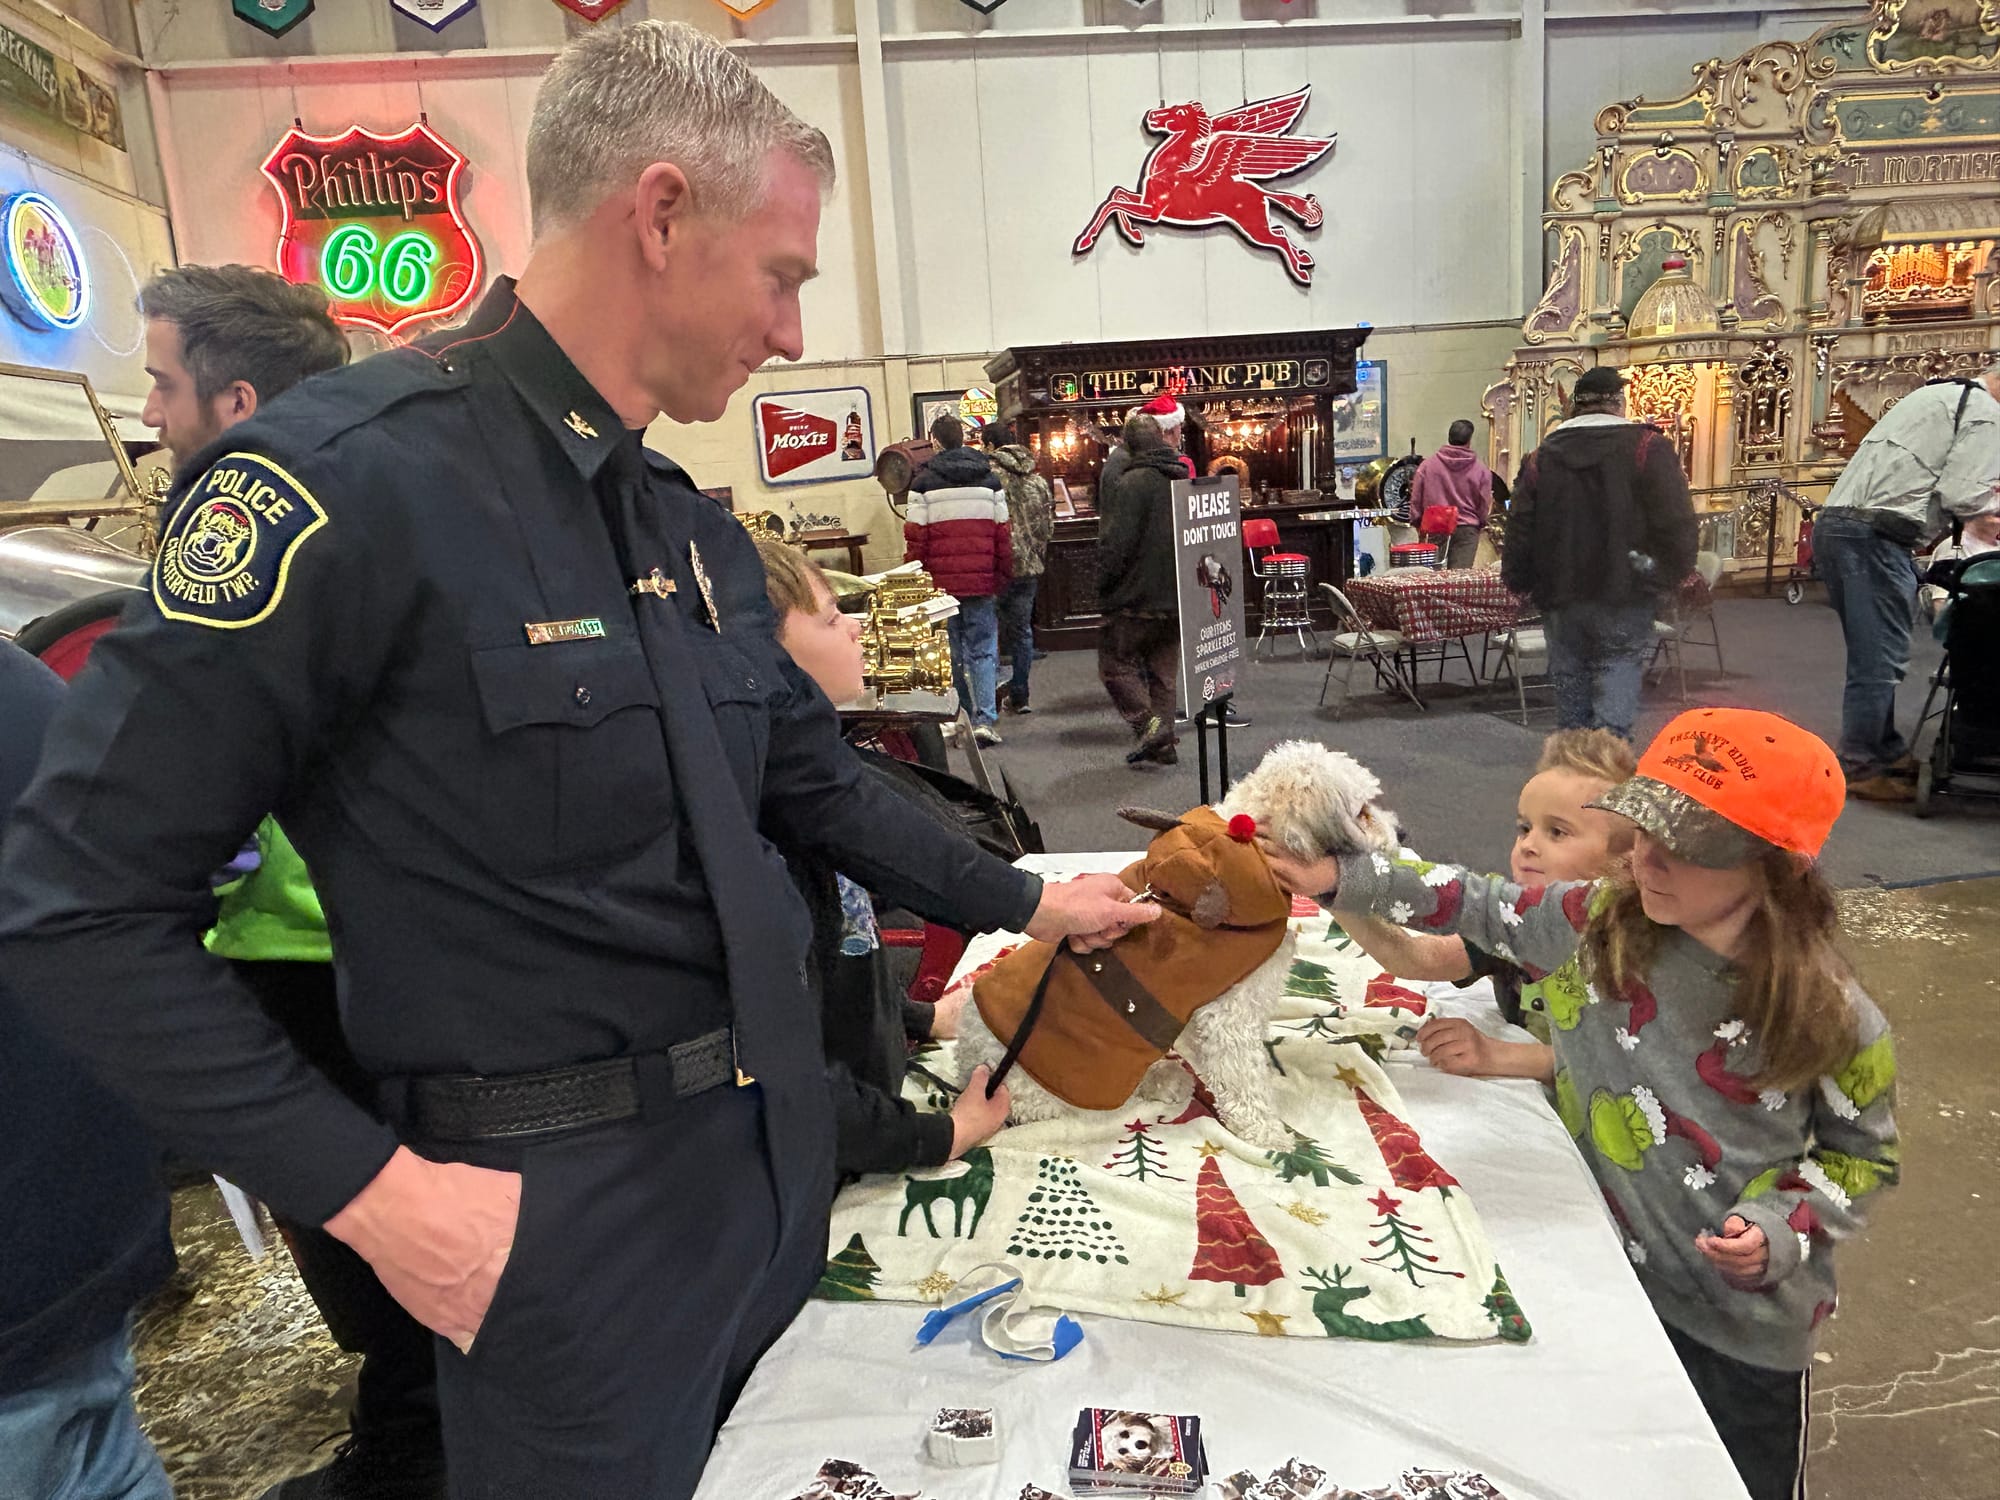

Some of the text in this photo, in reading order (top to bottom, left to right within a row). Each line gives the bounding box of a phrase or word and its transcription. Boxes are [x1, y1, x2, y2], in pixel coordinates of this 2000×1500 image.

[280, 152, 445, 220] Phillips
[321, 224, 437, 306] 66
[1089, 371, 1138, 392] THE
[1244, 363, 1291, 386] PUB
[768, 431, 829, 454] MOXIE
[205, 469, 294, 526] POLICE
[1188, 491, 1231, 520] PLEASE
[1211, 521, 1237, 540] TOUCH
[219, 571, 260, 602] TWP.
[1693, 769, 1724, 790] CLUB
